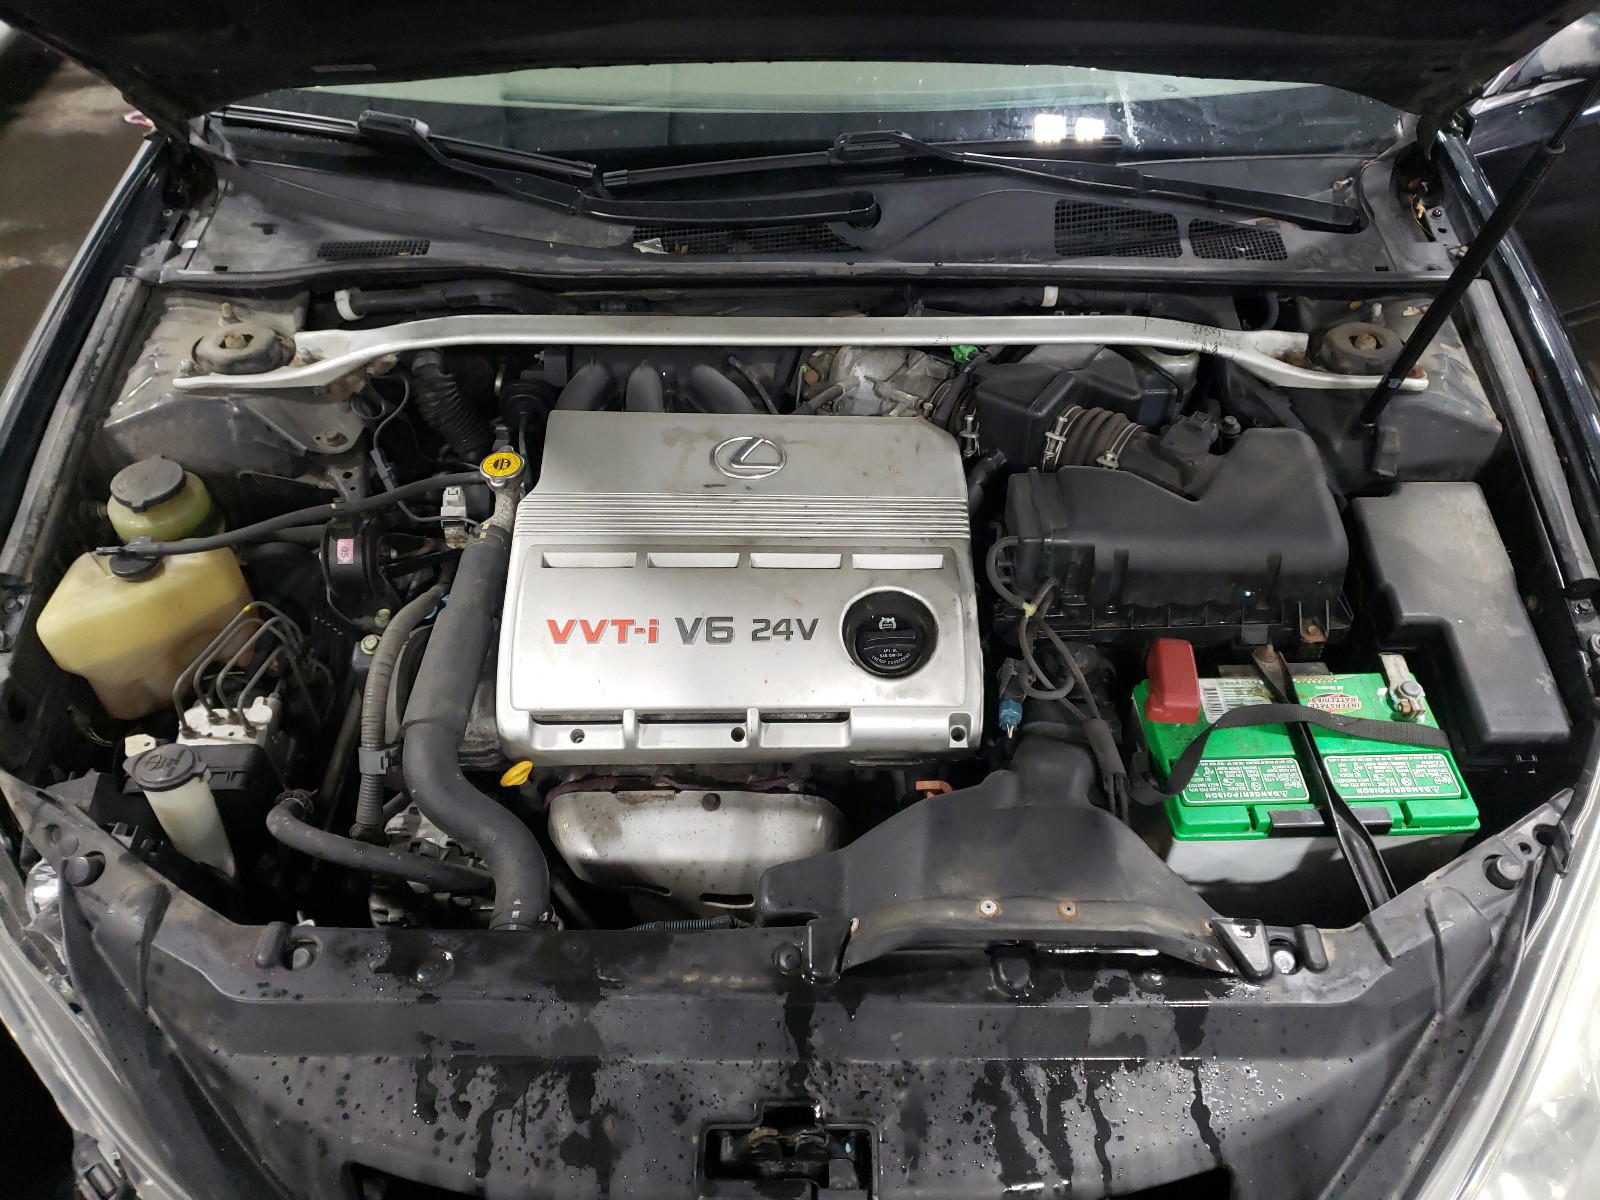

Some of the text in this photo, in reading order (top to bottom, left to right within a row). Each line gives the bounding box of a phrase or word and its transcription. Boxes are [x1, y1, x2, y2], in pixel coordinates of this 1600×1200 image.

[546, 616, 819, 645] VVT-i V6 24V
